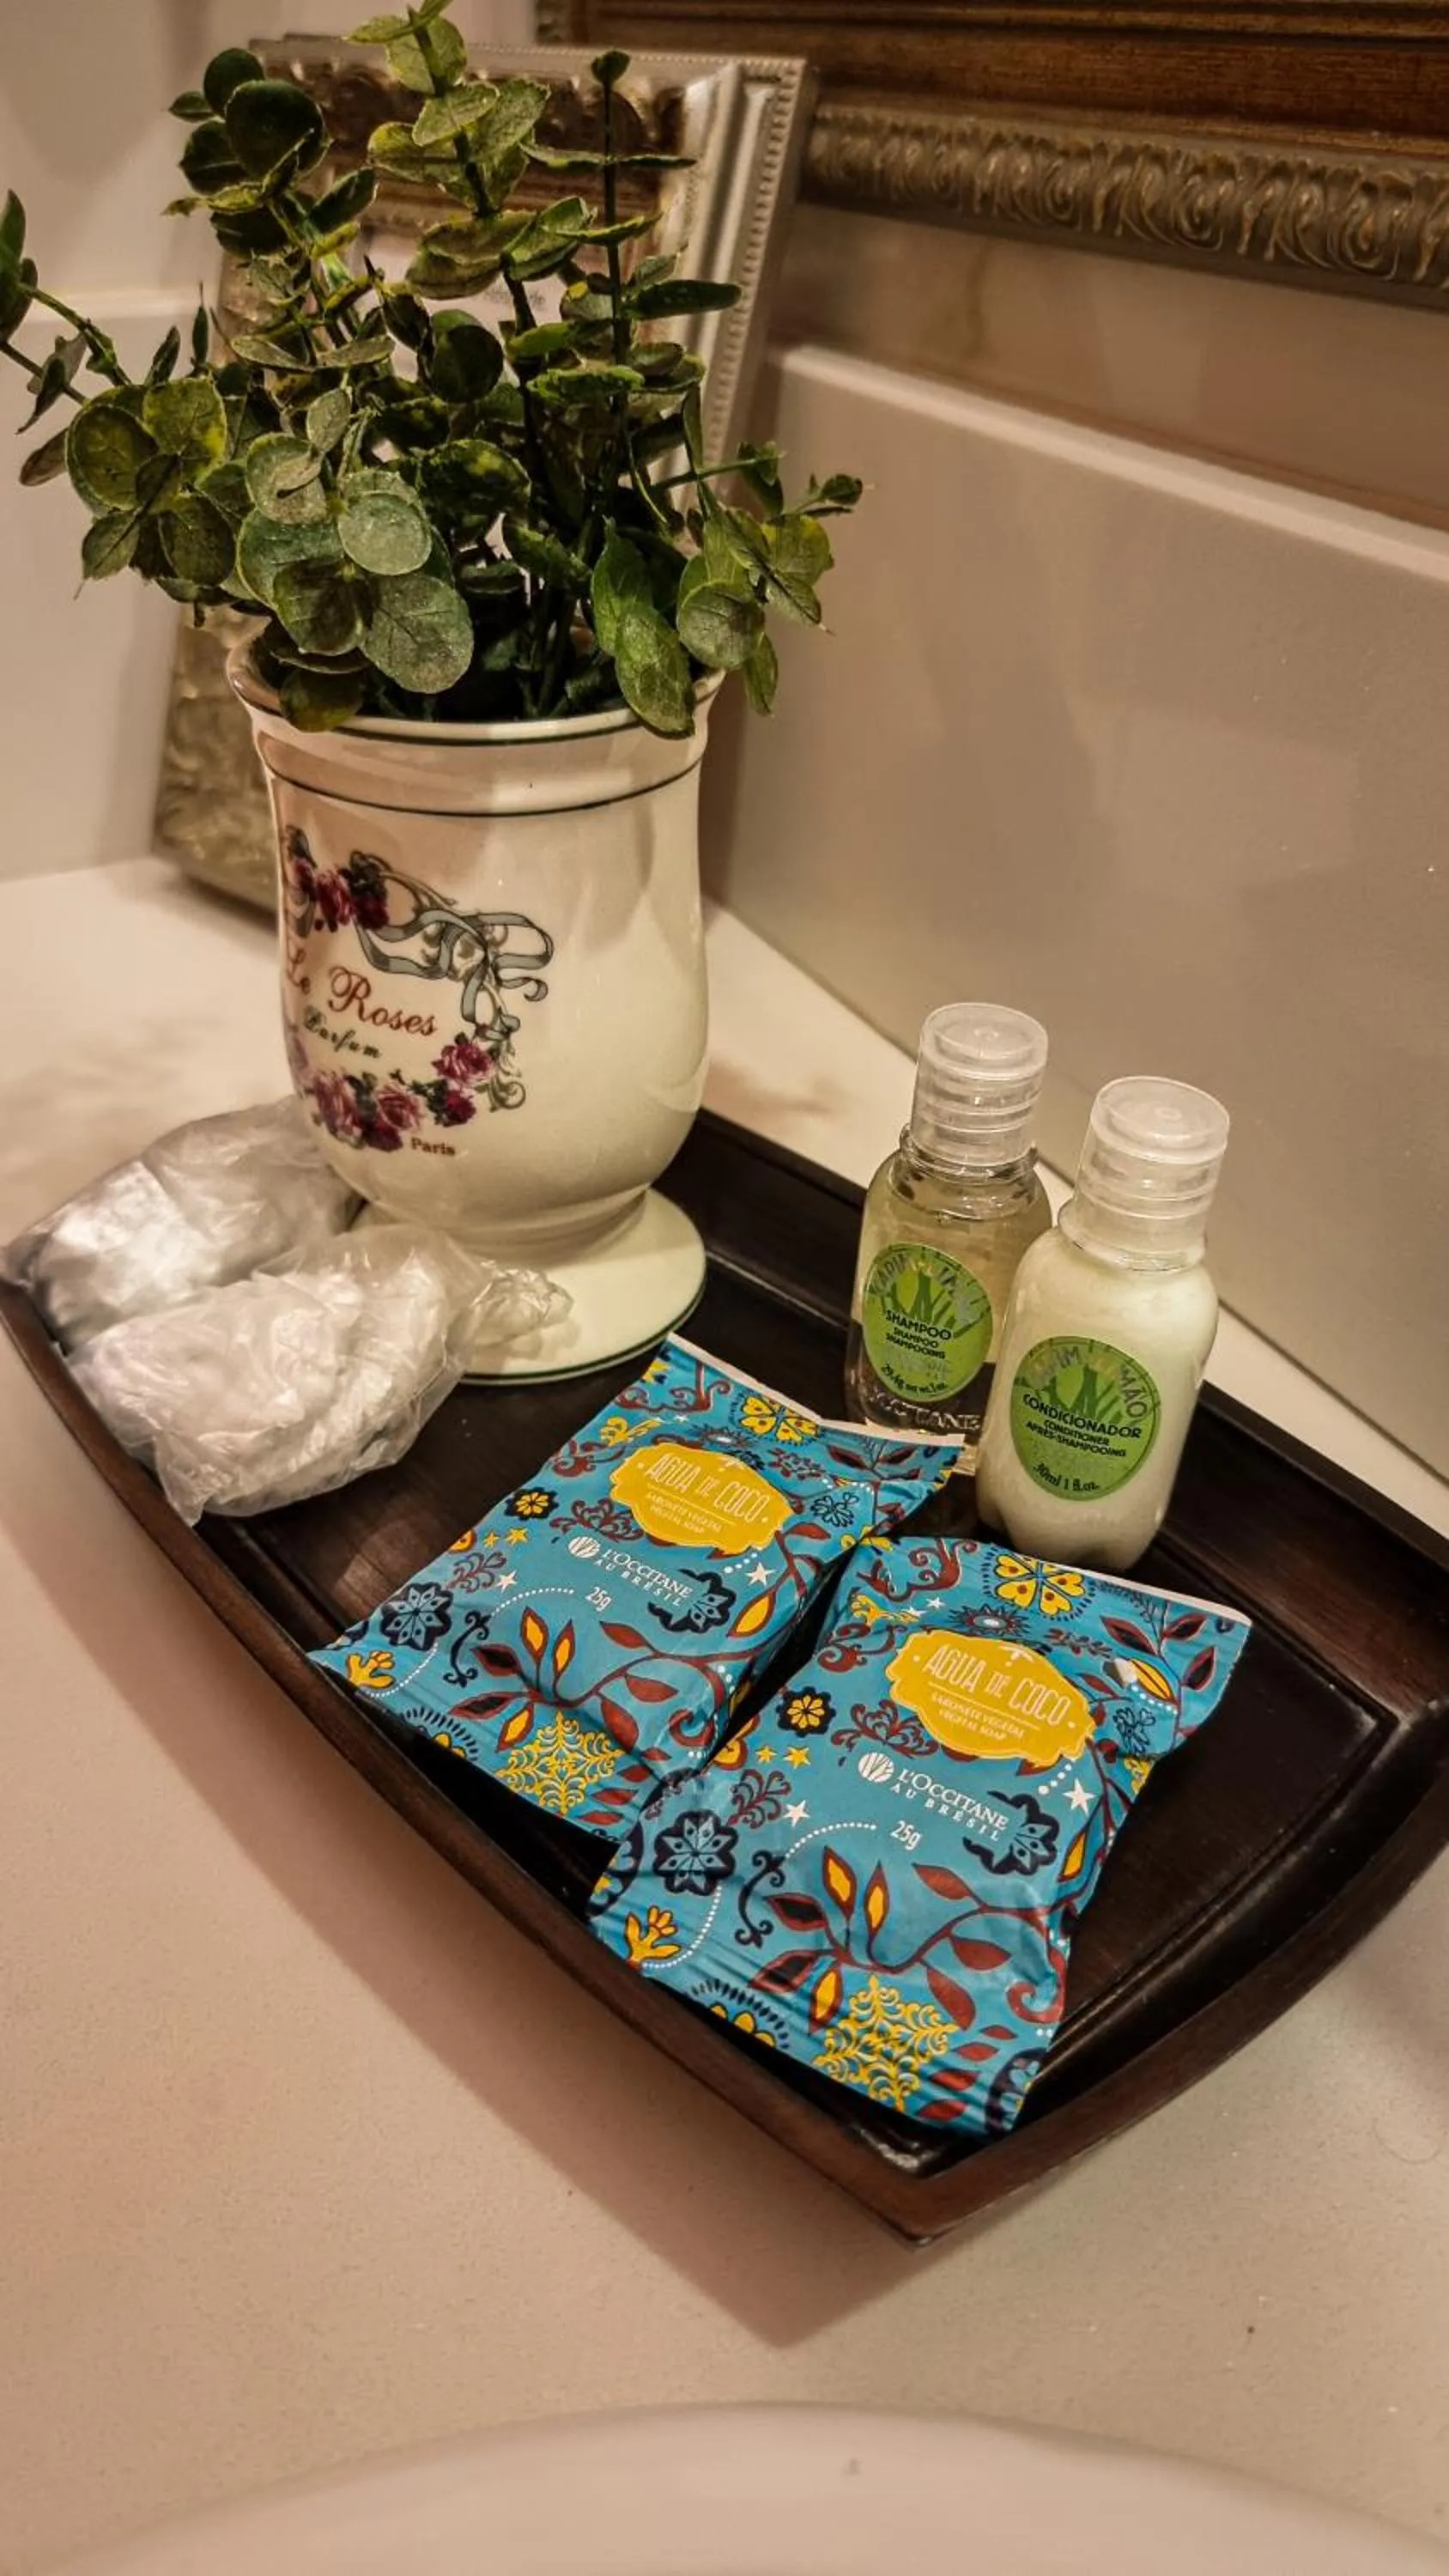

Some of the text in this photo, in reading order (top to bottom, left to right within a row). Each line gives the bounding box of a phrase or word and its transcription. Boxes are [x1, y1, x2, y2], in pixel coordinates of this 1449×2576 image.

[327, 965, 438, 1036] Roses
[411, 1136, 456, 1157] Paris
[885, 1309, 952, 1340] SHAMPOO
[1022, 1393, 1143, 1439] CONDICIONADOR
[713, 1480, 770, 1523] COCO
[602, 1548, 694, 1600] L'OCCITANE
[585, 1586, 613, 1612] 25g
[984, 1670, 1011, 1699] DE
[1008, 1676, 1072, 1727] COCO
[890, 1782, 918, 1800] AU
[898, 1768, 1010, 1832] L'OCCITANE
[889, 1819, 923, 1851] 25g
